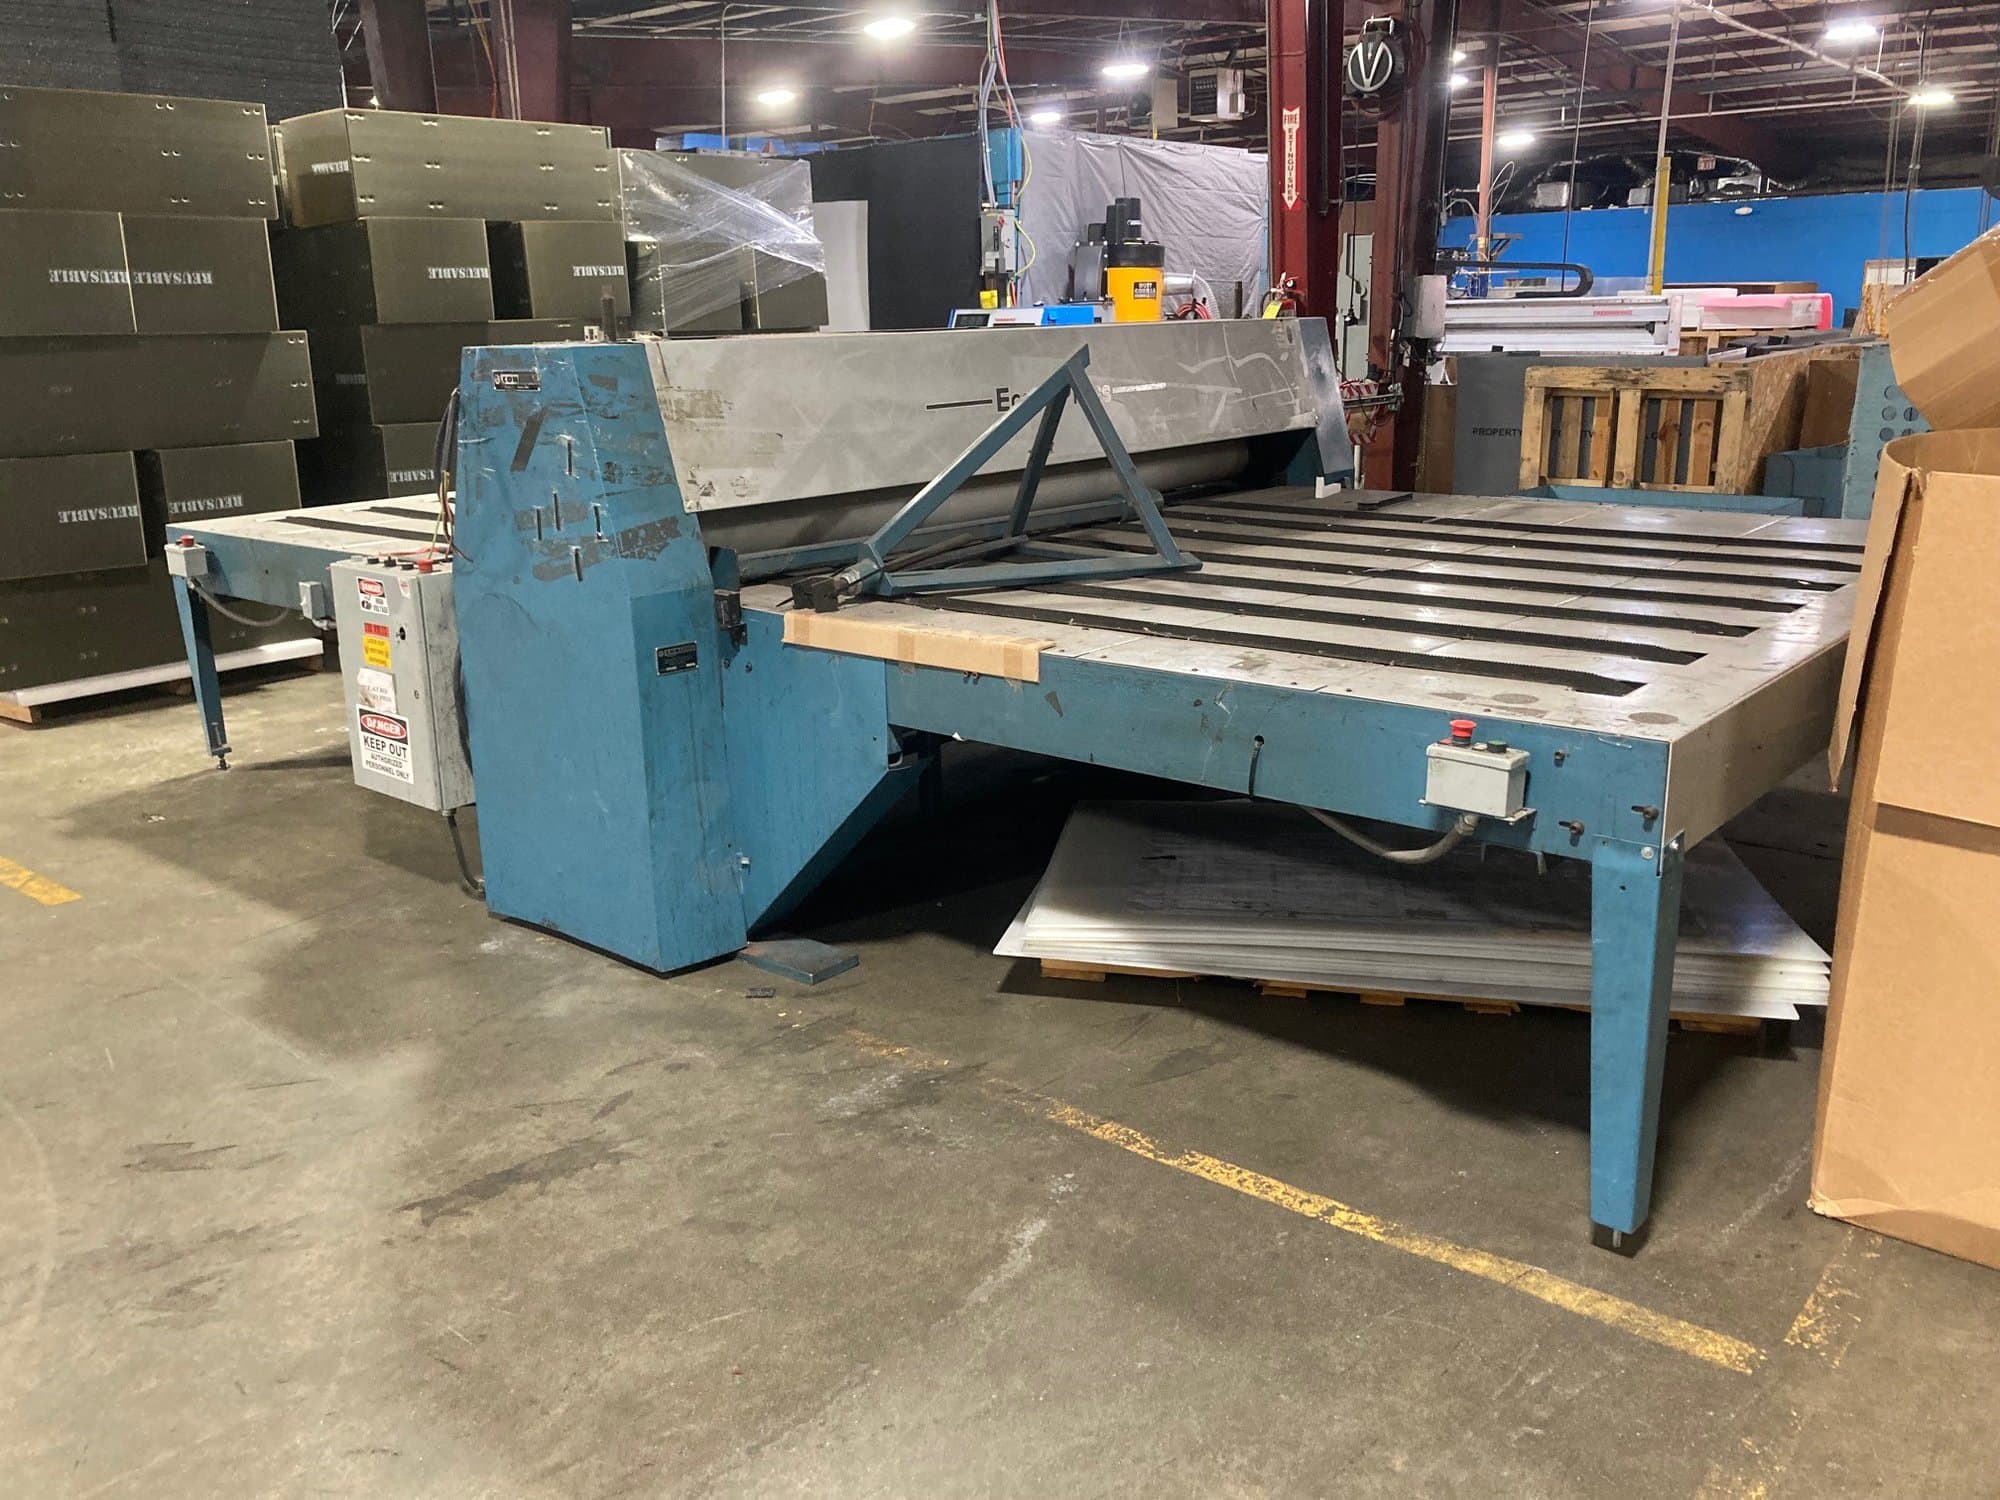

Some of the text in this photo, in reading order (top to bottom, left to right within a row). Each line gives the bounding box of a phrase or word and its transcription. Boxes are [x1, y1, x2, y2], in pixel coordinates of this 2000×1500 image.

[1284, 114, 1298, 124] FIRE
[49, 270, 129, 284] REUSABLE
[134, 271, 213, 285] REUSABLE
[428, 267, 489, 279] REUSABLE
[573, 265, 625, 277] REUSABLE
[389, 470, 434, 483] USABLE
[168, 495, 242, 513] REUSABLE
[58, 505, 138, 523] REUSABLE
[366, 717, 401, 736] DANGER
[363, 735, 407, 758] KEEP OUT
[371, 753, 402, 768] AUTHORIZED
[366, 759, 409, 779] PERSONNEL ONLY
